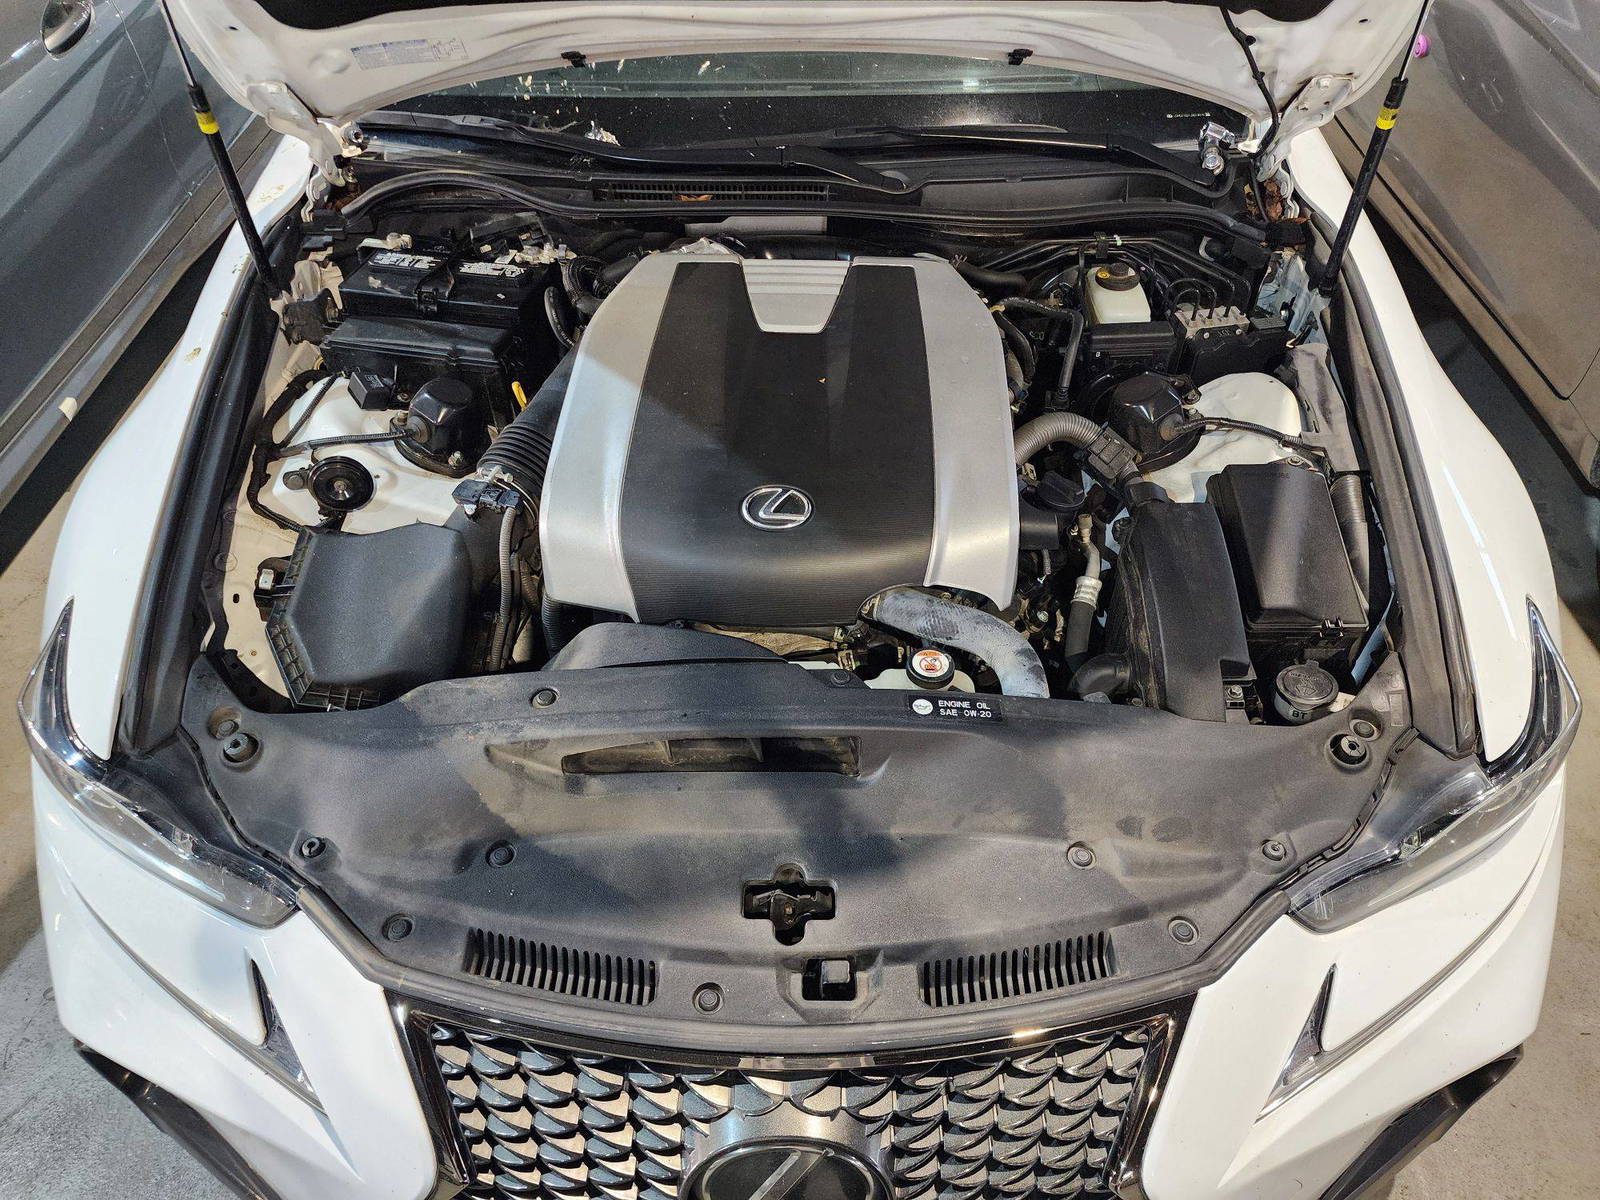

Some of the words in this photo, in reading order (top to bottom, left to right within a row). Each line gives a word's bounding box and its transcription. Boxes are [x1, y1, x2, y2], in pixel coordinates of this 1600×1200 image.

[938, 700, 970, 709] ENGINE
[976, 702, 991, 710] OIL
[939, 708, 958, 717] SAE
[1292, 710, 1307, 719] BT
